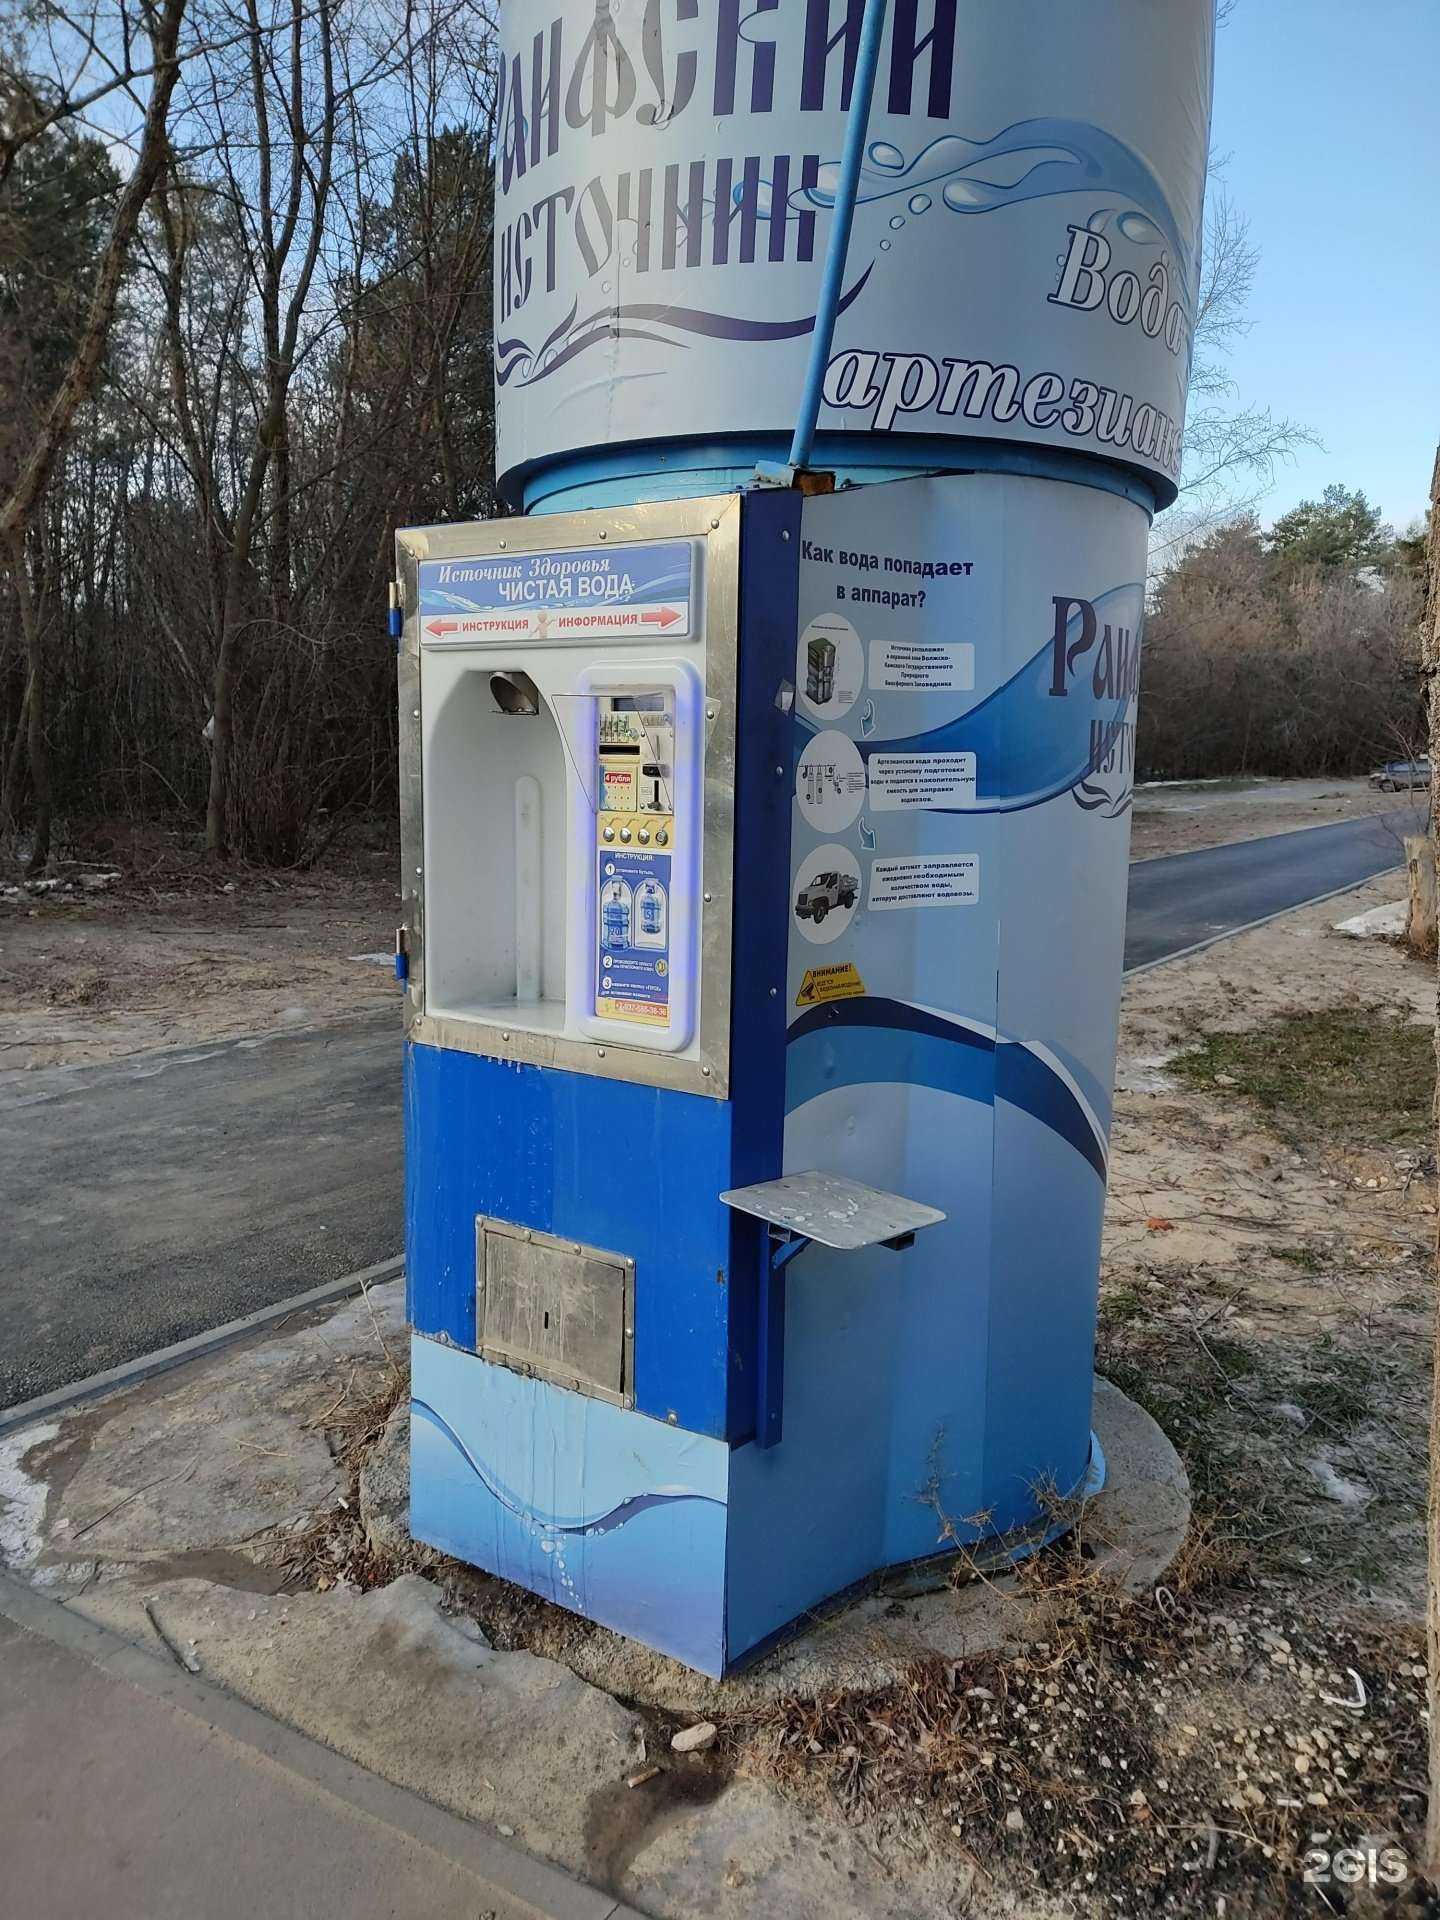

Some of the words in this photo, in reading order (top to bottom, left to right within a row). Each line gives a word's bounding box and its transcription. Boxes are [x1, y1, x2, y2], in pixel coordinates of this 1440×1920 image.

[500, 155, 819, 324] ИСТОЧНИК
[1047, 224, 1184, 356] Вода
[438, 564, 522, 584] Источник
[528, 556, 610, 581] Здоровья
[802, 540, 834, 563] Как
[839, 551, 879, 572] вода
[884, 557, 974, 579] попадает
[499, 577, 572, 601] ЧИСТАЯ
[578, 574, 633, 600] ВОДА
[836, 585, 846, 599] в
[851, 586, 926, 609] аппарат?
[462, 619, 529, 632] ИНСТРУКЦИЯ
[558, 614, 638, 628] ИНФОРМАЦИЯ
[611, 774, 631, 783] рубля
[913, 871, 965, 879] необходимым
